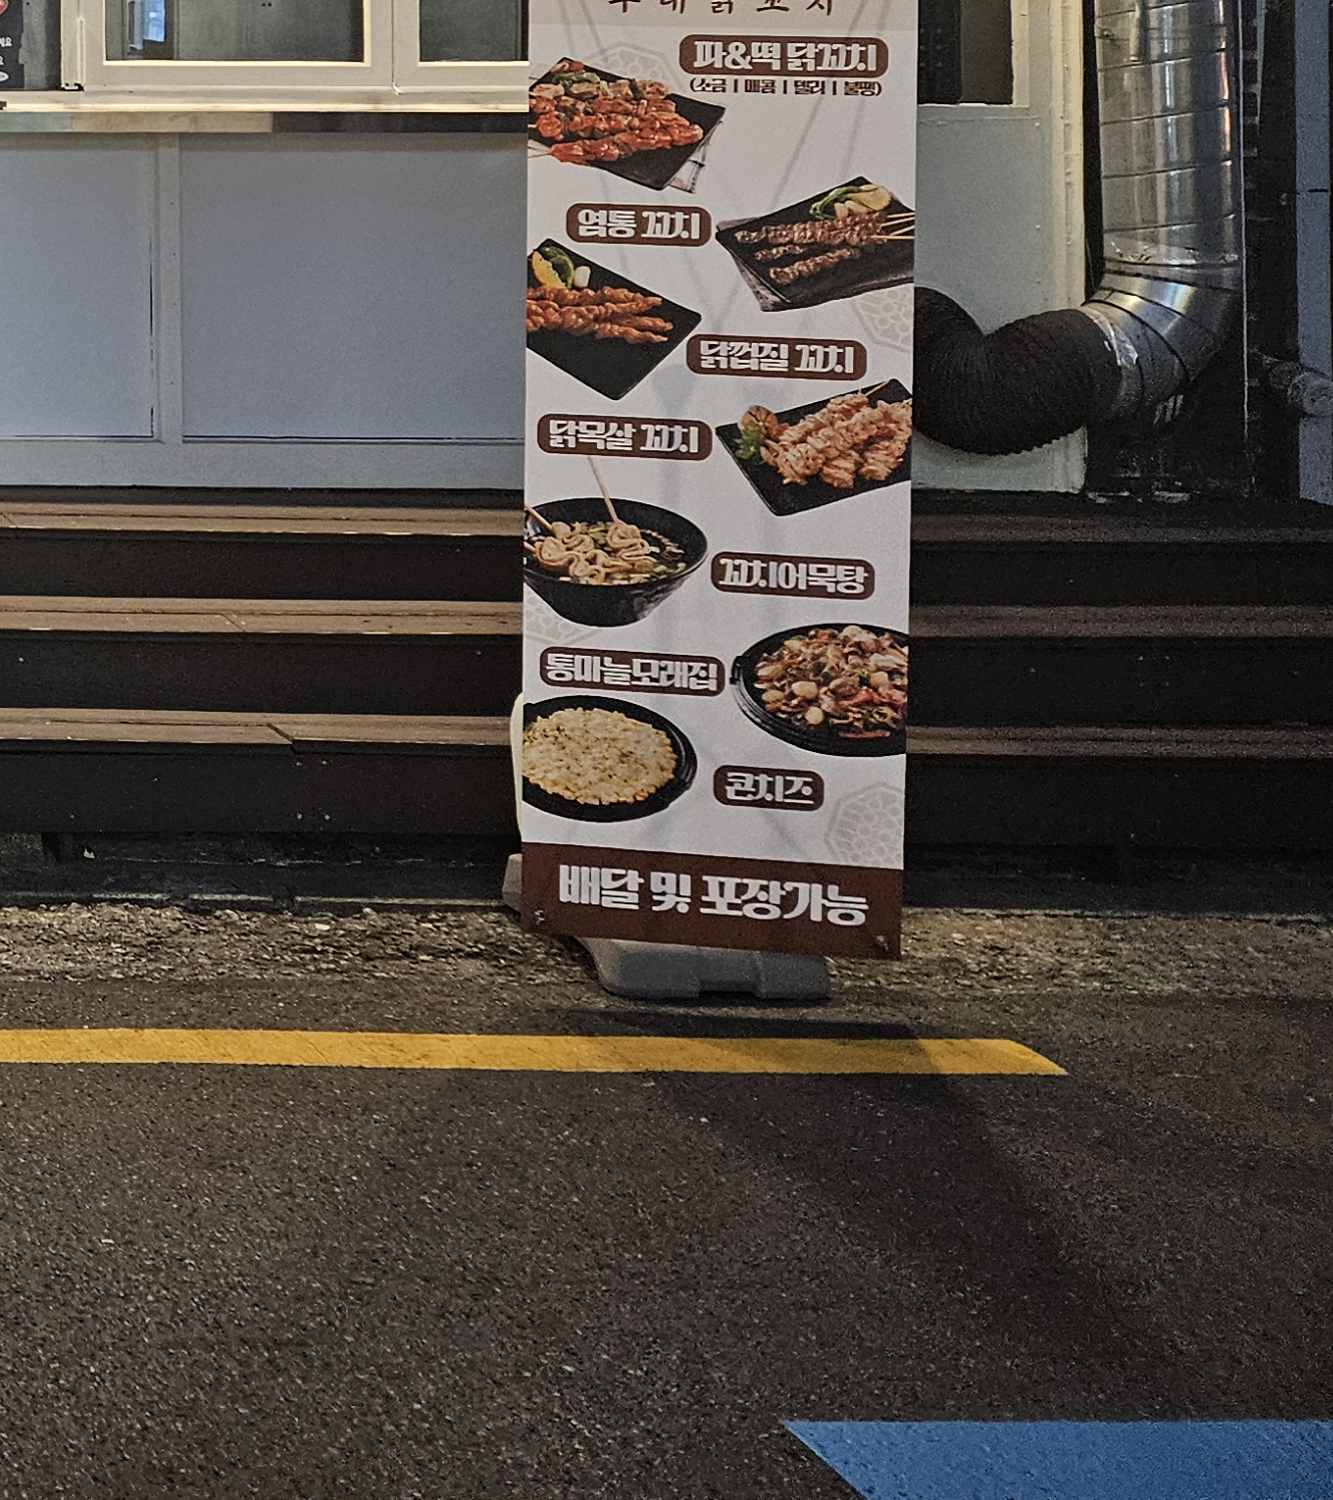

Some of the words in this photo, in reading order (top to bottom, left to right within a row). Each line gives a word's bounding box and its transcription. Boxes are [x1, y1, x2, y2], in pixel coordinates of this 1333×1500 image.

[693, 40, 782, 71] 파&떡
[787, 42, 878, 72] 닭꼬치
[578, 208, 637, 238] 염통
[640, 211, 701, 240] 꼬치
[699, 340, 789, 372] 닭껍질
[794, 344, 854, 374] 꼬치
[549, 419, 637, 451] 닭목살
[640, 424, 699, 453] 꼬치
[718, 558, 869, 594] 꼬치어묵탕
[545, 653, 718, 691] 통마늘모래집
[725, 772, 815, 805] 콘치즈
[559, 864, 645, 910] 배달
[650, 871, 691, 913] 및
[699, 874, 870, 926] 포장가능
